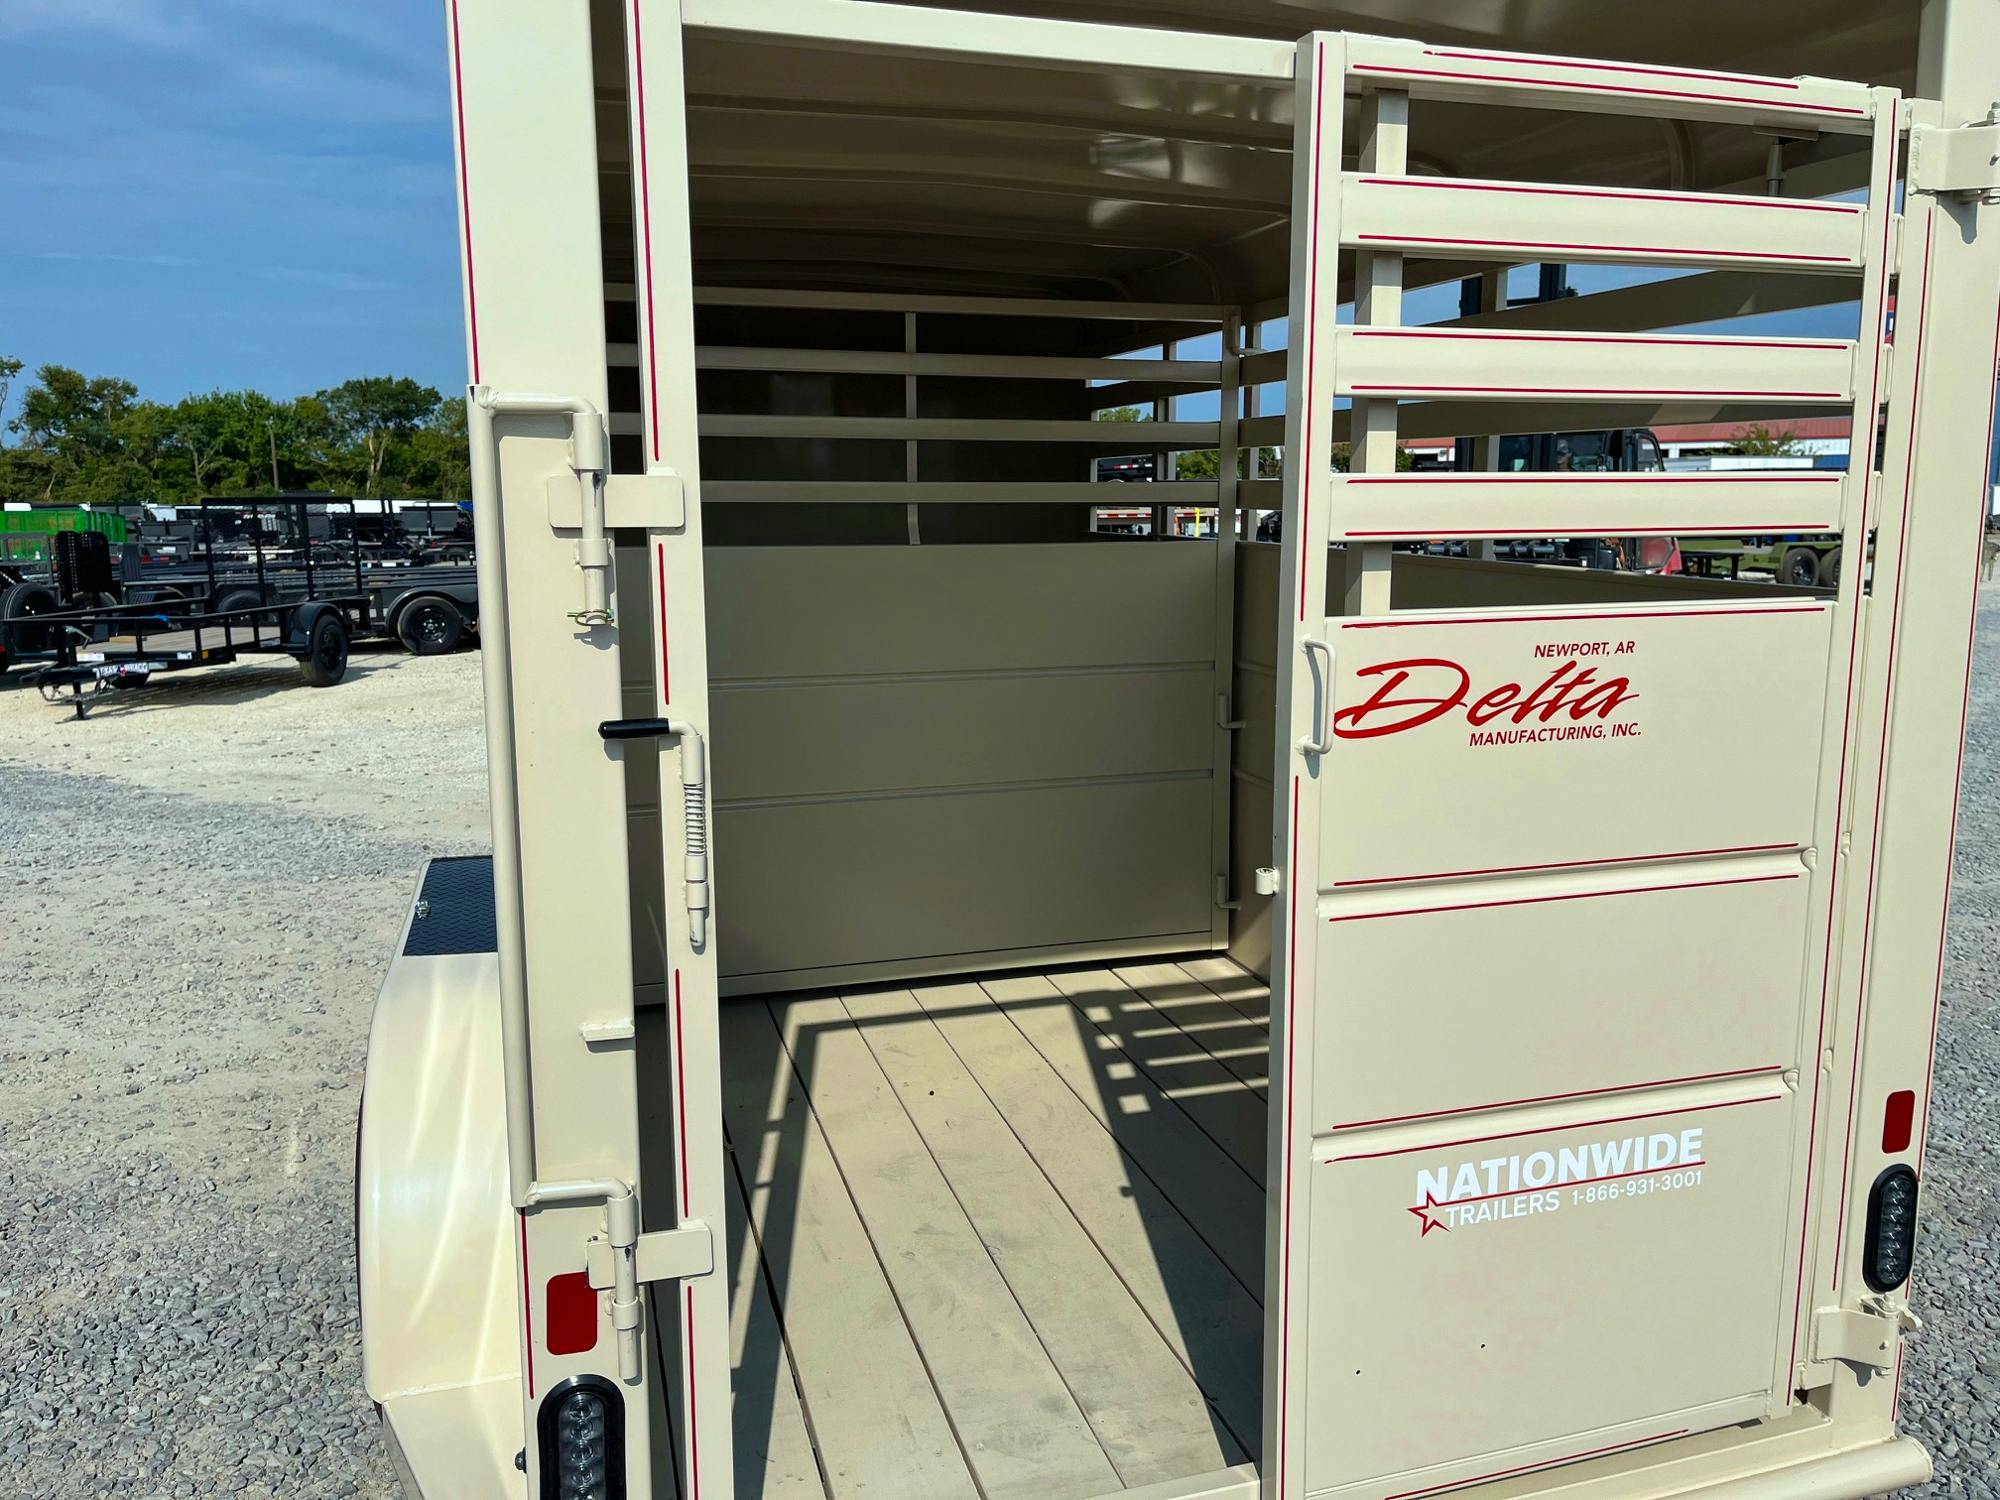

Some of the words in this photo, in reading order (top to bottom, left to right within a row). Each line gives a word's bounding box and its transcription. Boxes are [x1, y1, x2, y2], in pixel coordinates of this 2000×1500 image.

[1534, 641, 1610, 658] NEWPORT,
[1614, 641, 1635, 654] AR
[1333, 658, 1640, 739] Delta
[1469, 725, 1606, 747] MANUFACTURING,
[1611, 722, 1642, 738] INC.
[1416, 1128, 1703, 1206] NATIONWIDE
[1445, 1190, 1560, 1227] TRAILERS
[1572, 1170, 1702, 1205] 1-866-931-3001
